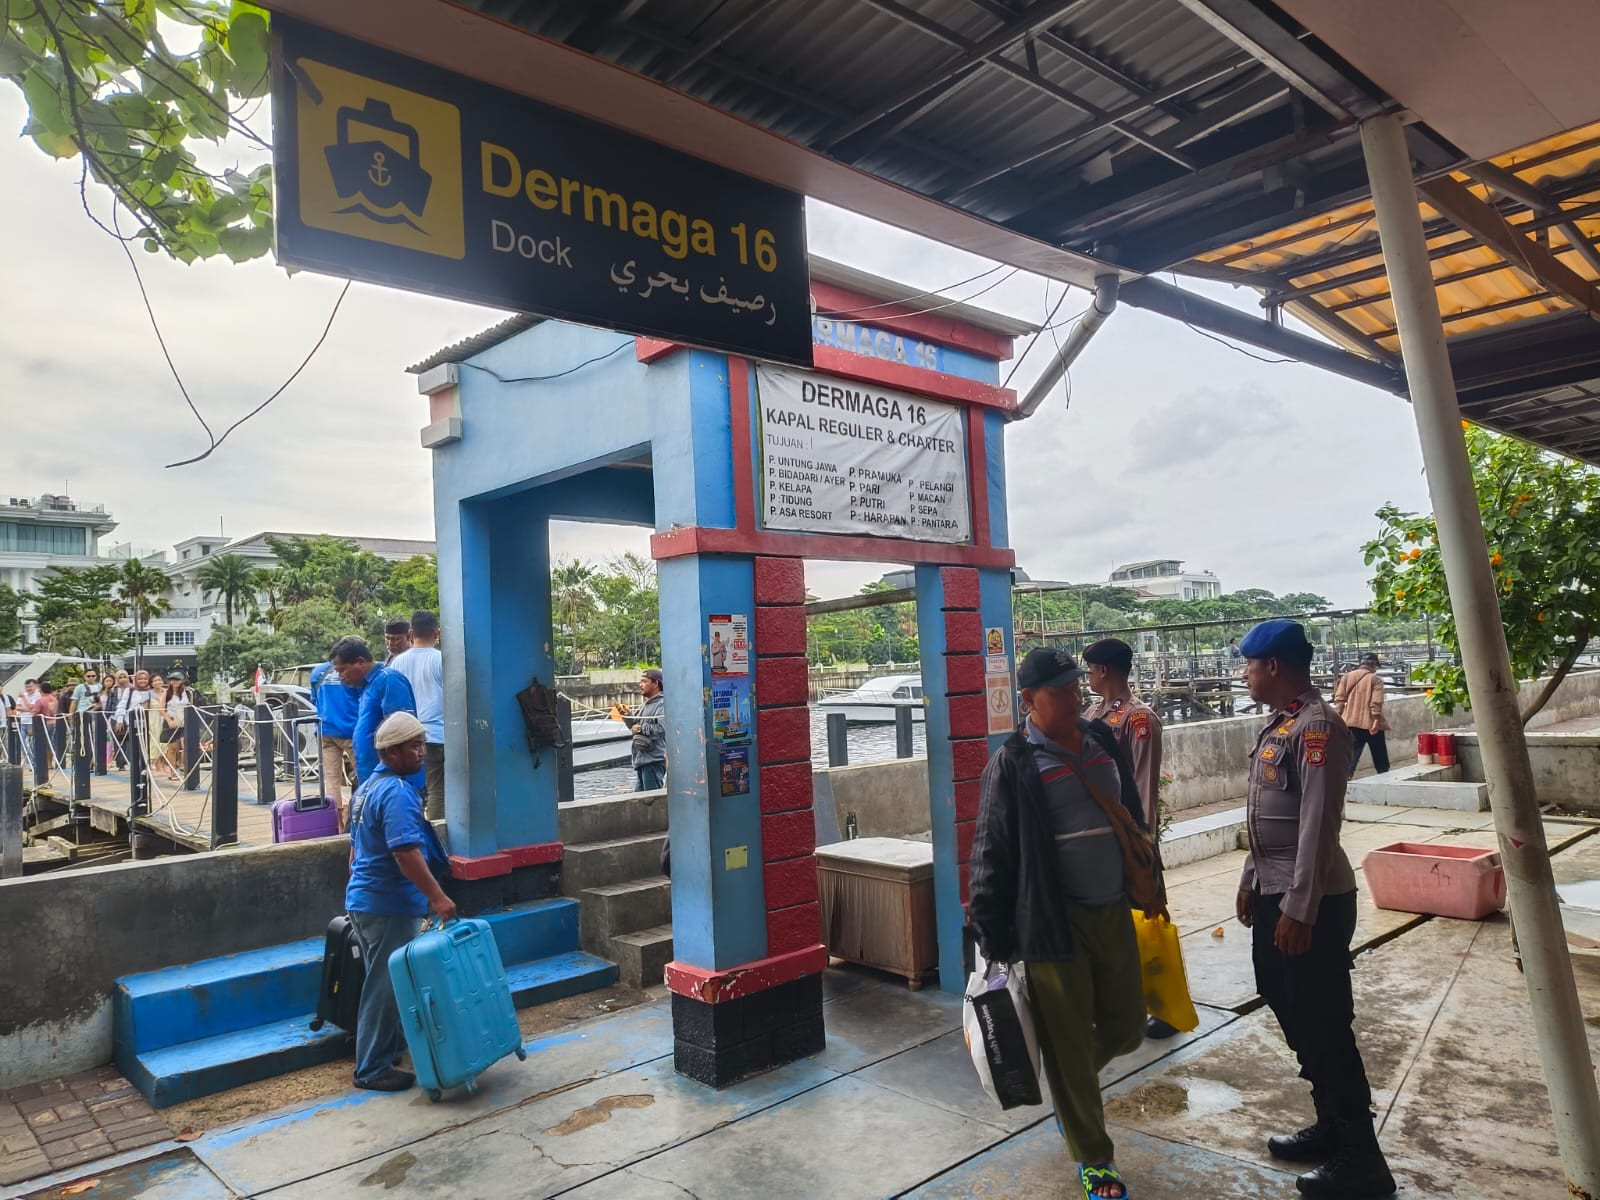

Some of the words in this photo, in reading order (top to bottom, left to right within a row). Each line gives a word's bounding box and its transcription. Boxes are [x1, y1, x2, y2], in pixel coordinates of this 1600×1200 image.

[481, 140, 716, 260] Dermaga
[731, 222, 777, 273] 16
[491, 219, 573, 269] Dock
[610, 259, 690, 301] بحري
[700, 276, 776, 326] رصيف
[817, 319, 907, 365] RMAGA
[915, 341, 937, 371] 16
[802, 380, 903, 421] DERMAGA
[907, 404, 927, 426] 16
[766, 407, 815, 431] KAPAL
[819, 417, 883, 442] REGULER
[887, 430, 895, 444] &
[898, 432, 956, 454] CHARTER
[767, 433, 803, 449] TUJUAN
[778, 456, 813, 470] UNTUNG
[815, 462, 837, 473] JAWA
[778, 469, 818, 483] BIDADARI
[824, 475, 846, 486] AYER
[858, 468, 902, 484] PRAMUKA
[779, 482, 812, 494] KELAPA
[859, 483, 880, 494] PARI
[920, 480, 954, 493] PELANGI
[859, 497, 886, 509] PUTRI
[917, 493, 946, 504] MACAN
[779, 507, 797, 518] ASA
[798, 509, 832, 520] RESORT
[918, 505, 938, 516] SEPA
[863, 512, 907, 526] HARAPAN
[921, 517, 958, 529] PANTARA
[981, 1003, 996, 1041] Puppies
[990, 1040, 1003, 1065] Hush
